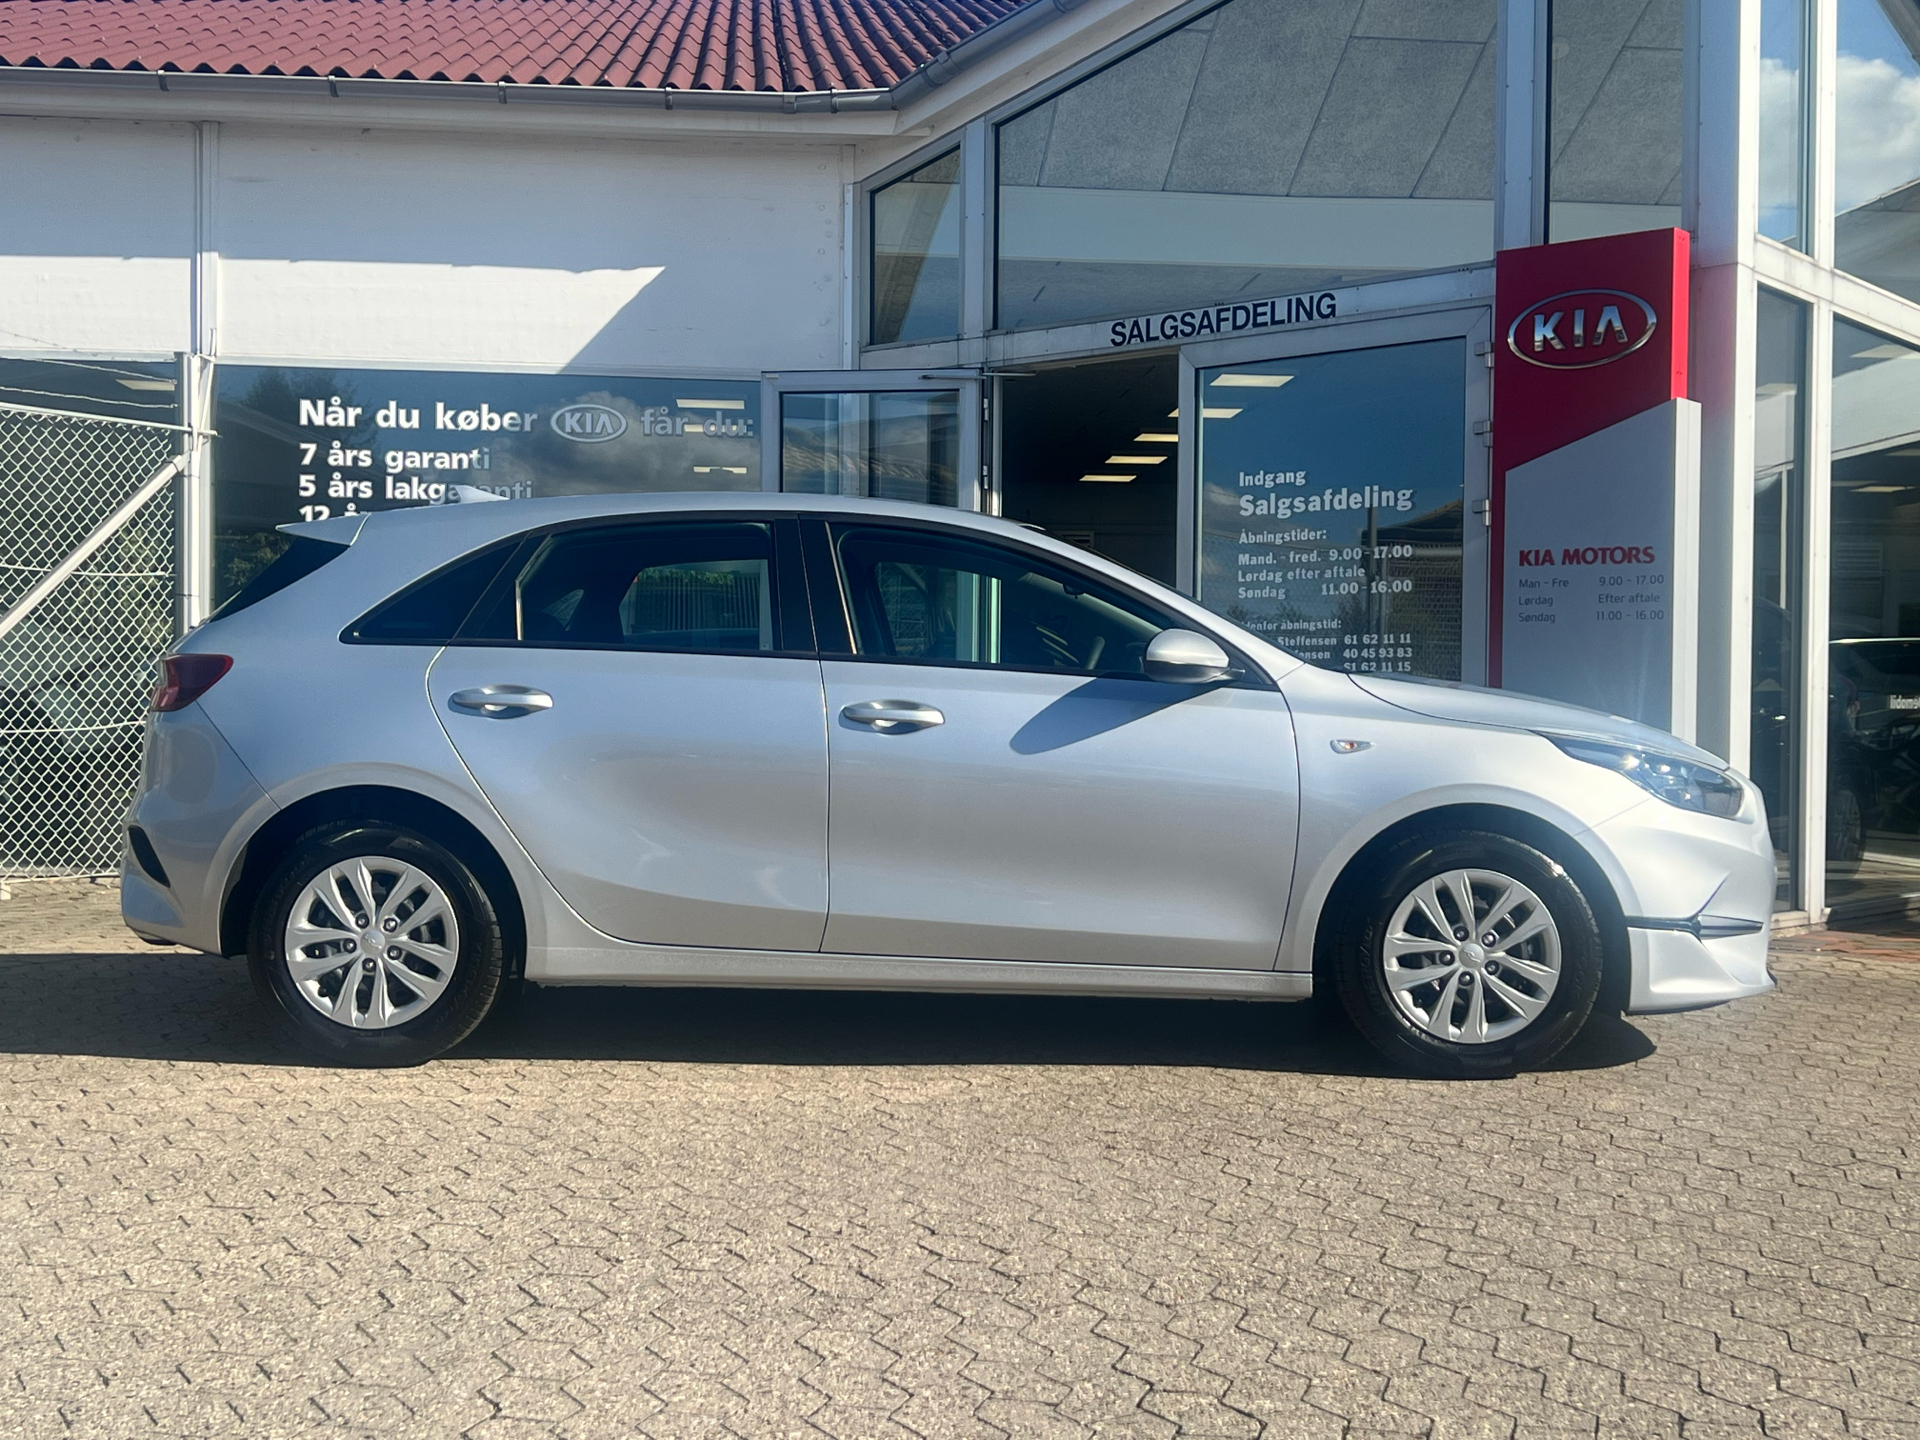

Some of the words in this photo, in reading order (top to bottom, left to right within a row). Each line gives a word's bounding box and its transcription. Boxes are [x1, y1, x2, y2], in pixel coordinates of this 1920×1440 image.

[1110, 293, 1337, 347] SALGSAFDELING
[1533, 305, 1629, 352] KIA
[299, 396, 362, 427] Når
[375, 400, 420, 429] du
[435, 401, 538, 432] køber
[564, 412, 614, 434] KIA
[641, 406, 689, 437] får
[703, 411, 754, 437] du:
[299, 442, 318, 466] 7
[327, 440, 373, 468] års
[385, 446, 490, 474] garanti
[1239, 470, 1307, 488] Indgang
[298, 474, 317, 498] 5
[327, 471, 373, 499] års
[385, 475, 533, 505] lakganti
[1239, 485, 1413, 519] Salgsafdeling
[1238, 528, 1328, 545] Åbningstider:
[1238, 552, 1277, 566] Mand.
[1289, 550, 1322, 563] fred.
[1518, 549, 1556, 567] KIA
[1561, 546, 1656, 566] MOTORS
[1287, 567, 1321, 580] efter
[1324, 565, 1366, 579] aftale
[1518, 578, 1541, 589] Man
[1552, 577, 1570, 588] Fre
[1599, 575, 1623, 587] 9.00
[1635, 574, 1665, 586] 17.00
[1518, 595, 1554, 607] Lørdag
[1598, 593, 1625, 604] Efter
[1628, 592, 1661, 603] aftale
[1280, 618, 1342, 631] åbningstid:
[1518, 612, 1556, 624] Søndag
[1596, 610, 1623, 621] 11.00
[1635, 609, 1665, 621] 16.00
[1277, 635, 1337, 647] Steffensen
[1344, 635, 1357, 645] 61
[1362, 634, 1378, 645] 62
[1383, 634, 1394, 645] 11
[1399, 633, 1411, 644] 11
[1343, 649, 1358, 659] 40
[1361, 648, 1376, 659] 45
[1378, 648, 1394, 658] 93
[1397, 647, 1413, 658] 83
[1381, 661, 1393, 672] 11
[1397, 661, 1411, 672] 15
